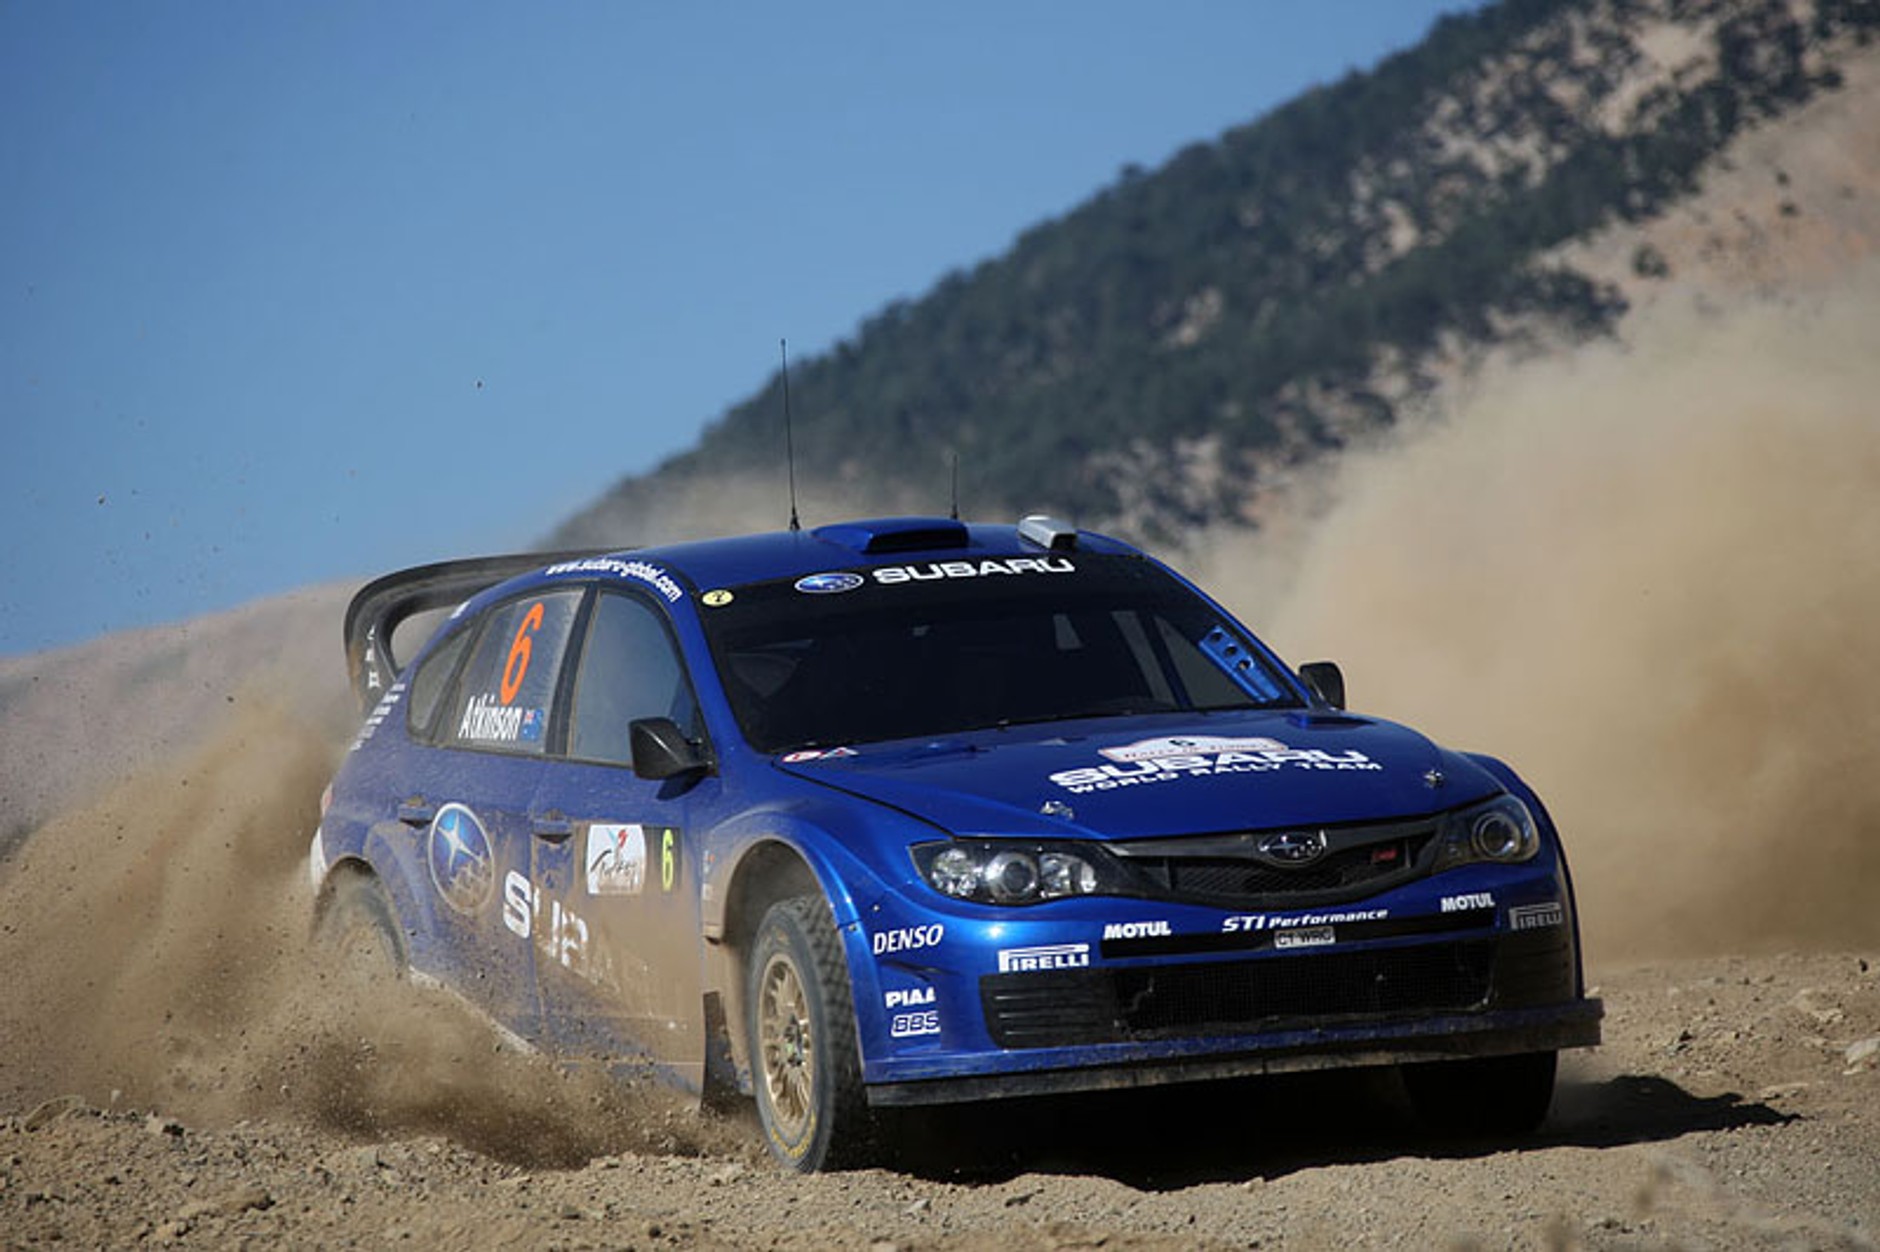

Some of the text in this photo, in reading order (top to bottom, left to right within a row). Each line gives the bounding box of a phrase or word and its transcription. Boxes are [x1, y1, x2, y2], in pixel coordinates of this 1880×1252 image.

[872, 558, 1076, 584] SUBARU
[500, 601, 545, 706] 6
[458, 693, 523, 741] Atkinson
[1049, 749, 1370, 788] SUBARU
[1067, 761, 1383, 794] WORLD RALLY TEAM
[661, 828, 674, 892] 6
[1441, 892, 1495, 913] MOTUL
[1103, 920, 1172, 940] MOTUL
[1222, 909, 1388, 933] STI Performance
[873, 923, 944, 955] DENSO
[998, 943, 1089, 973] PIRELLI
